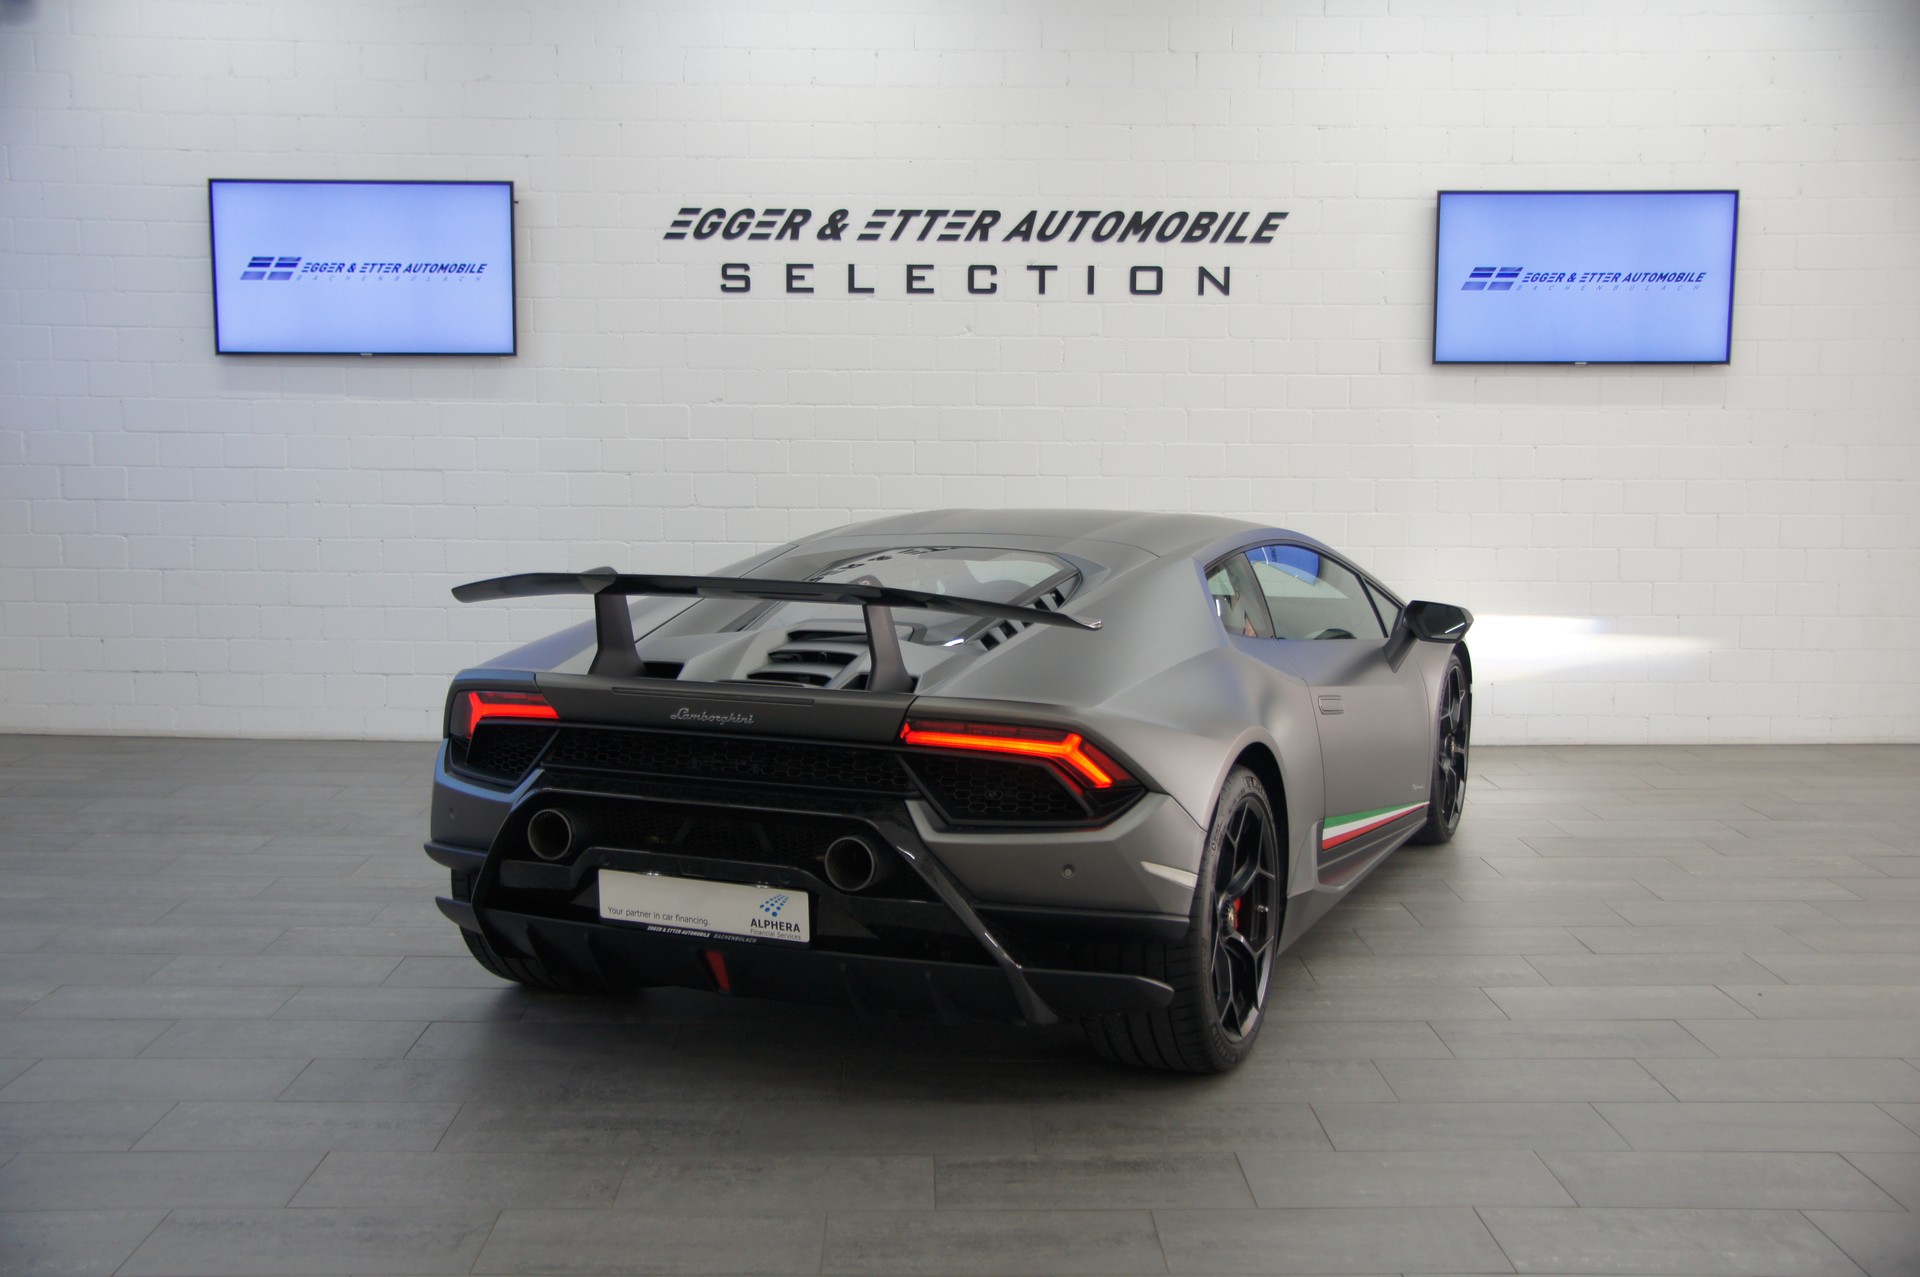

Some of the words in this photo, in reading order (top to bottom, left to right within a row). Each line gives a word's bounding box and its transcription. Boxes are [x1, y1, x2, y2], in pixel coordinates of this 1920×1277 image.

[664, 207, 811, 241] EGGER
[816, 208, 849, 241] &
[857, 209, 1002, 242] ETTER
[1003, 210, 1289, 244] AUTOMOBILE
[302, 262, 345, 273] EGGER
[347, 262, 357, 273] &
[359, 262, 402, 273] ETTER
[403, 263, 488, 274] AUTOMOBILE
[720, 262, 1231, 296] SELECTION
[1522, 271, 1566, 283] EGGER
[1567, 272, 1577, 283] &
[1579, 271, 1622, 283] ETTER
[1622, 272, 1707, 283] AUTOMOBILE
[670, 707, 755, 725] Lamborghini
[607, 906, 624, 915] Your
[625, 909, 652, 919] partner
[653, 912, 661, 920] in
[675, 914, 711, 927] financing.
[750, 918, 801, 933] ALPHERA
[750, 929, 776, 938] Financial
[777, 931, 802, 941] Services
